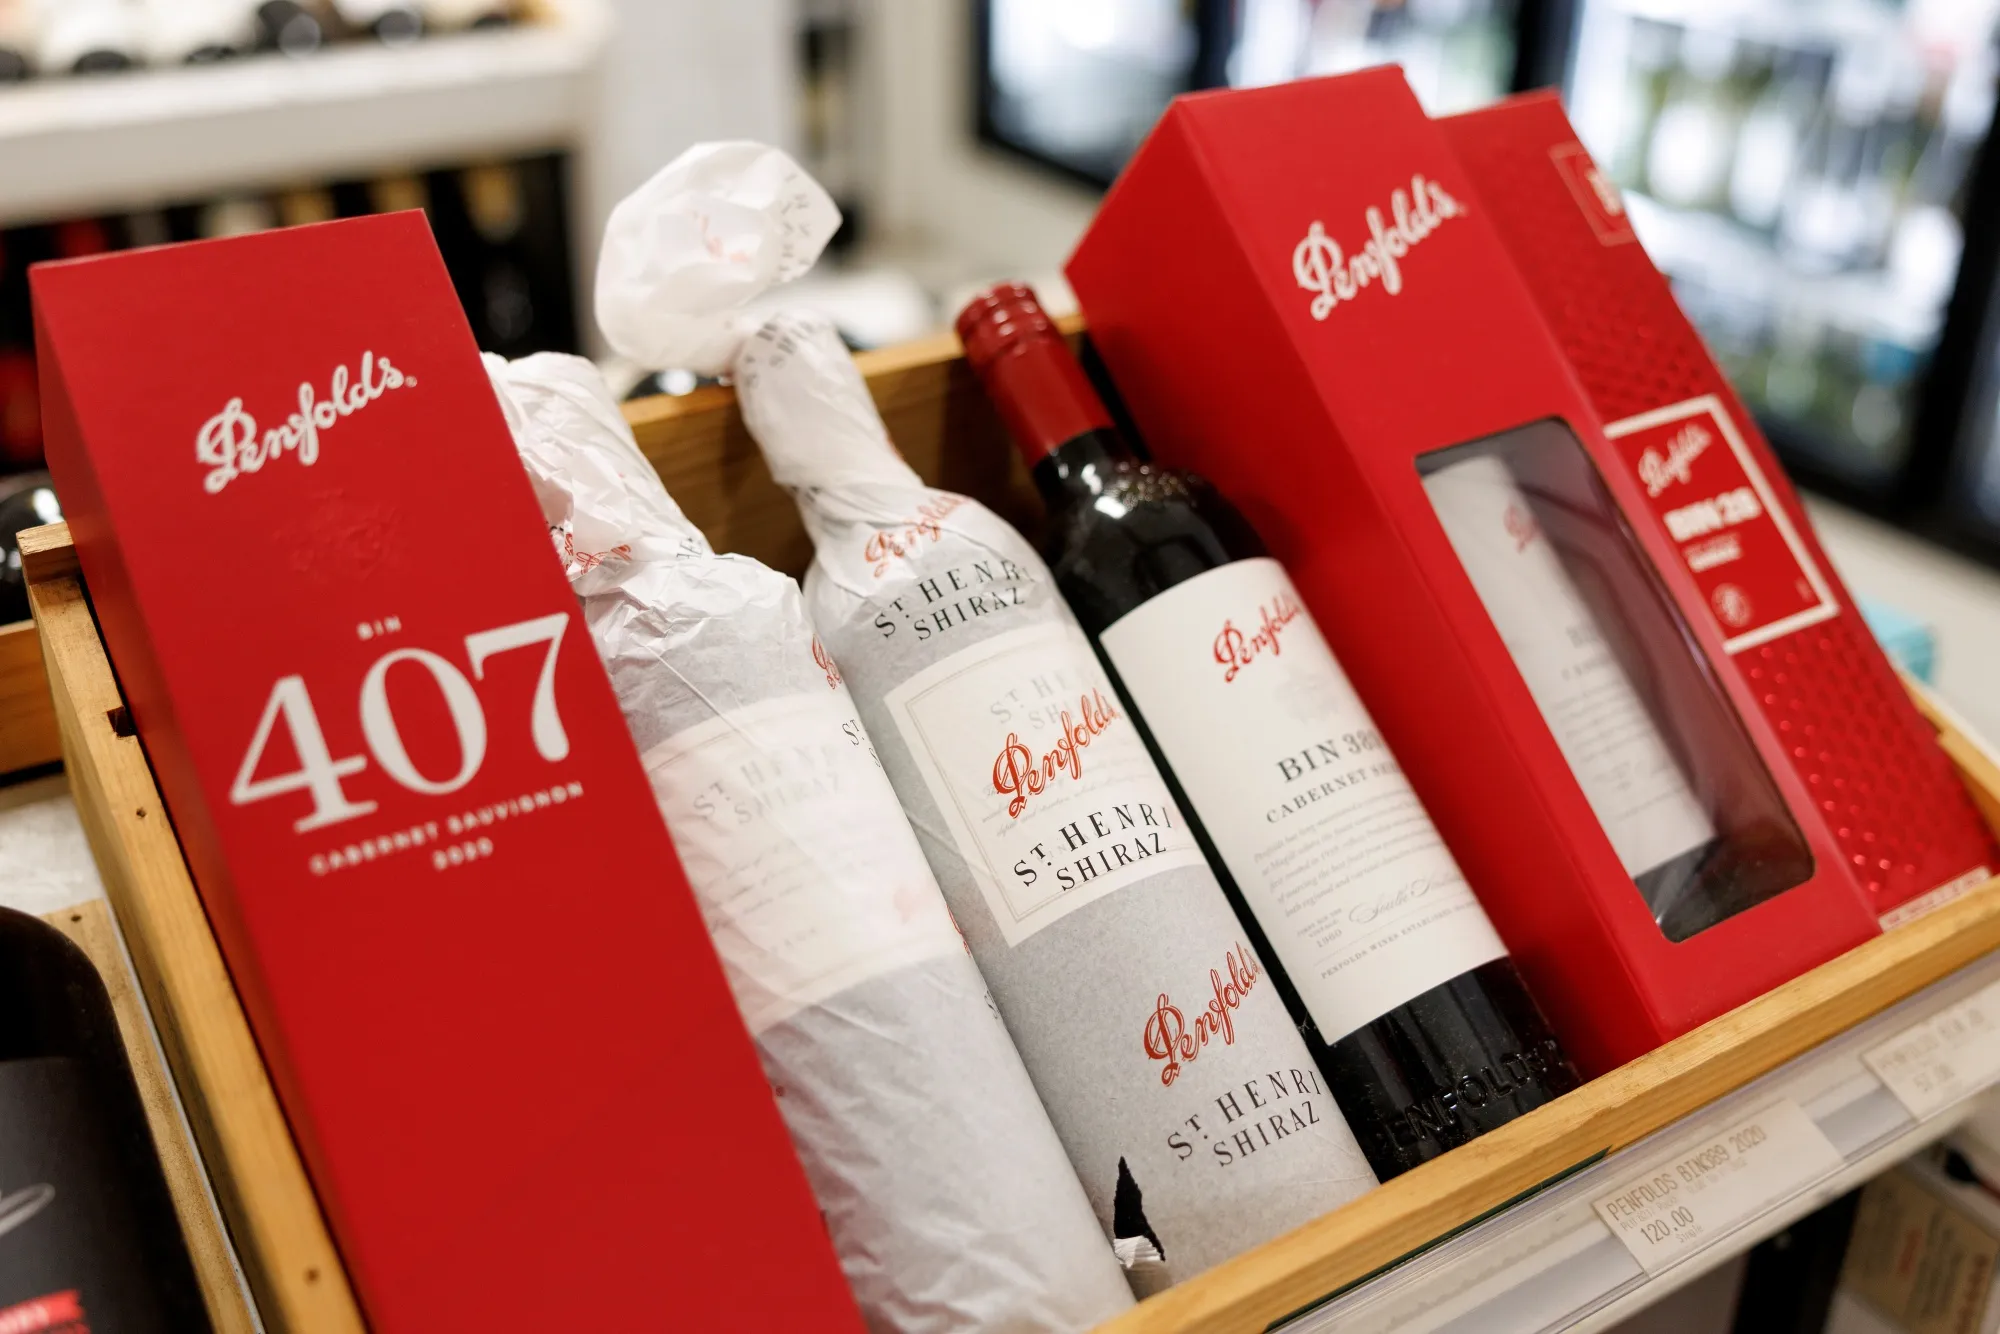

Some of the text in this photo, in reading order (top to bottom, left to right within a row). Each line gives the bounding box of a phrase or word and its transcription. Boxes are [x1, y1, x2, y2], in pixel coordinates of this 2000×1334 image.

[1291, 173, 1458, 321] Penfolds
[196, 350, 406, 494] Penfolds
[357, 615, 402, 641] BIN
[914, 587, 1025, 640] SHIRAZ
[230, 612, 570, 834] 407
[992, 686, 1119, 819] Penfolds
[1276, 739, 1341, 784] BIN
[1059, 801, 1173, 854] HENRI
[1266, 767, 1368, 824] CABERNET
[309, 780, 585, 876] CABERNET SAUVIGNON
[1056, 832, 1167, 892] SHIRAZ
[1143, 940, 1264, 1087] Penfolds
[1214, 1067, 1323, 1124] HENRI
[1212, 1100, 1321, 1168] SHIRAZ
[1606, 1172, 1678, 1222] PENFOLDS
[1674, 1143, 1731, 1183] BIN389
[1728, 1123, 1768, 1154] 2020
[1639, 1205, 1695, 1245] 120.00
